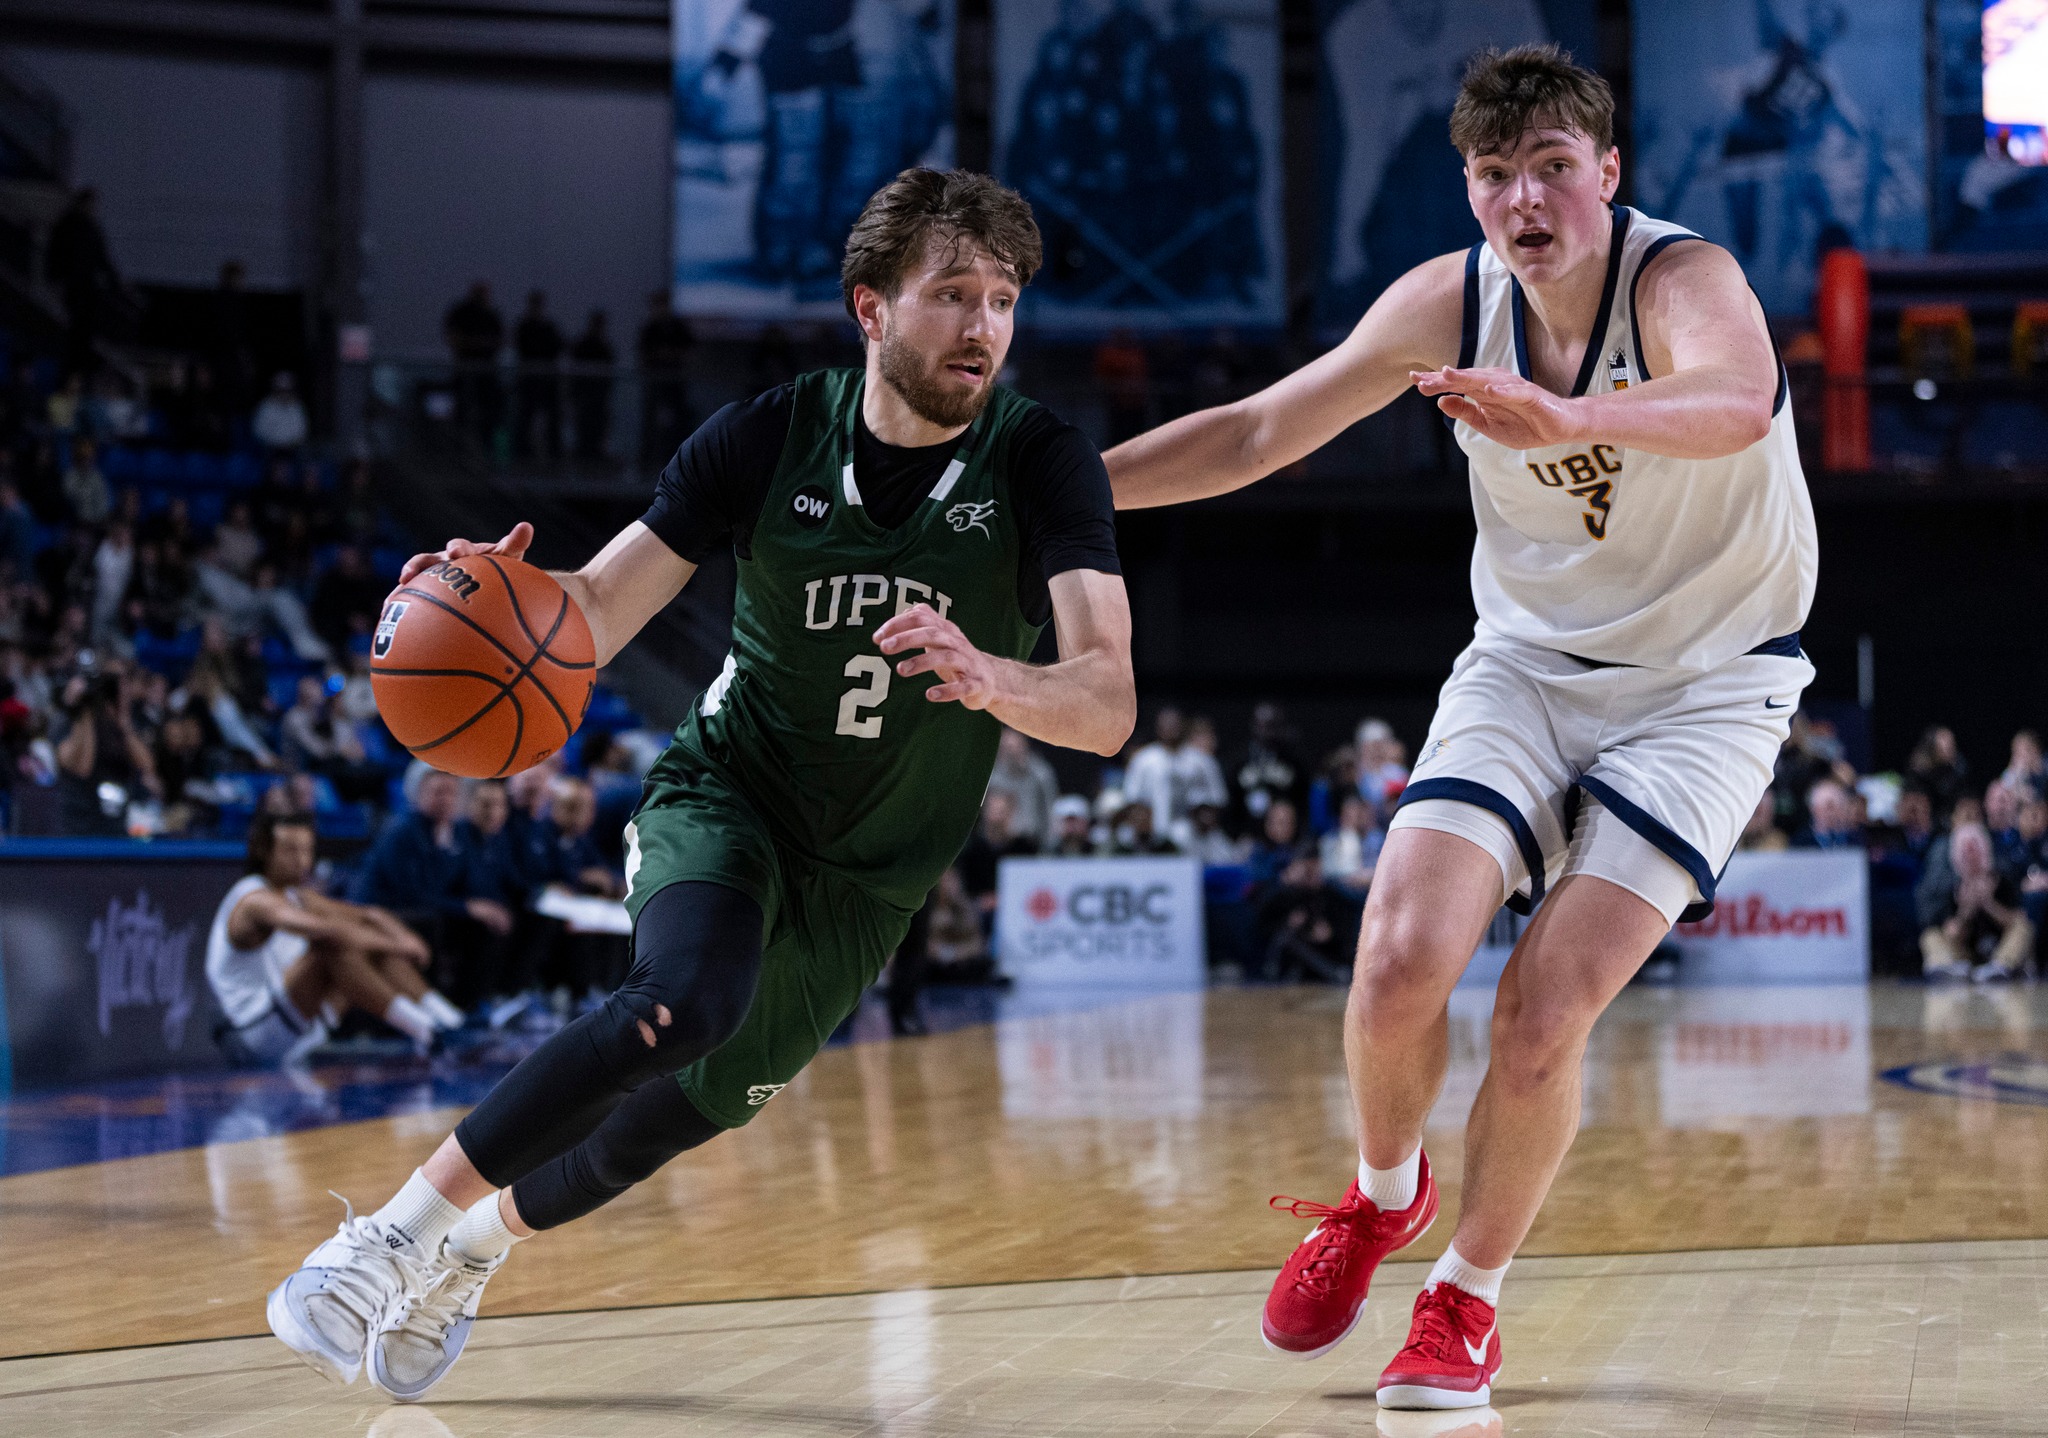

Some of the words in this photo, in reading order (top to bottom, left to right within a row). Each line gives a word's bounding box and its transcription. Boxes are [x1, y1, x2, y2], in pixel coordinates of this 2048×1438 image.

[1527, 444, 1622, 487] UBC
[794, 495, 829, 518] OW
[1565, 480, 1613, 541] 3
[835, 654, 891, 738] 2
[1067, 884, 1173, 926] CBC
